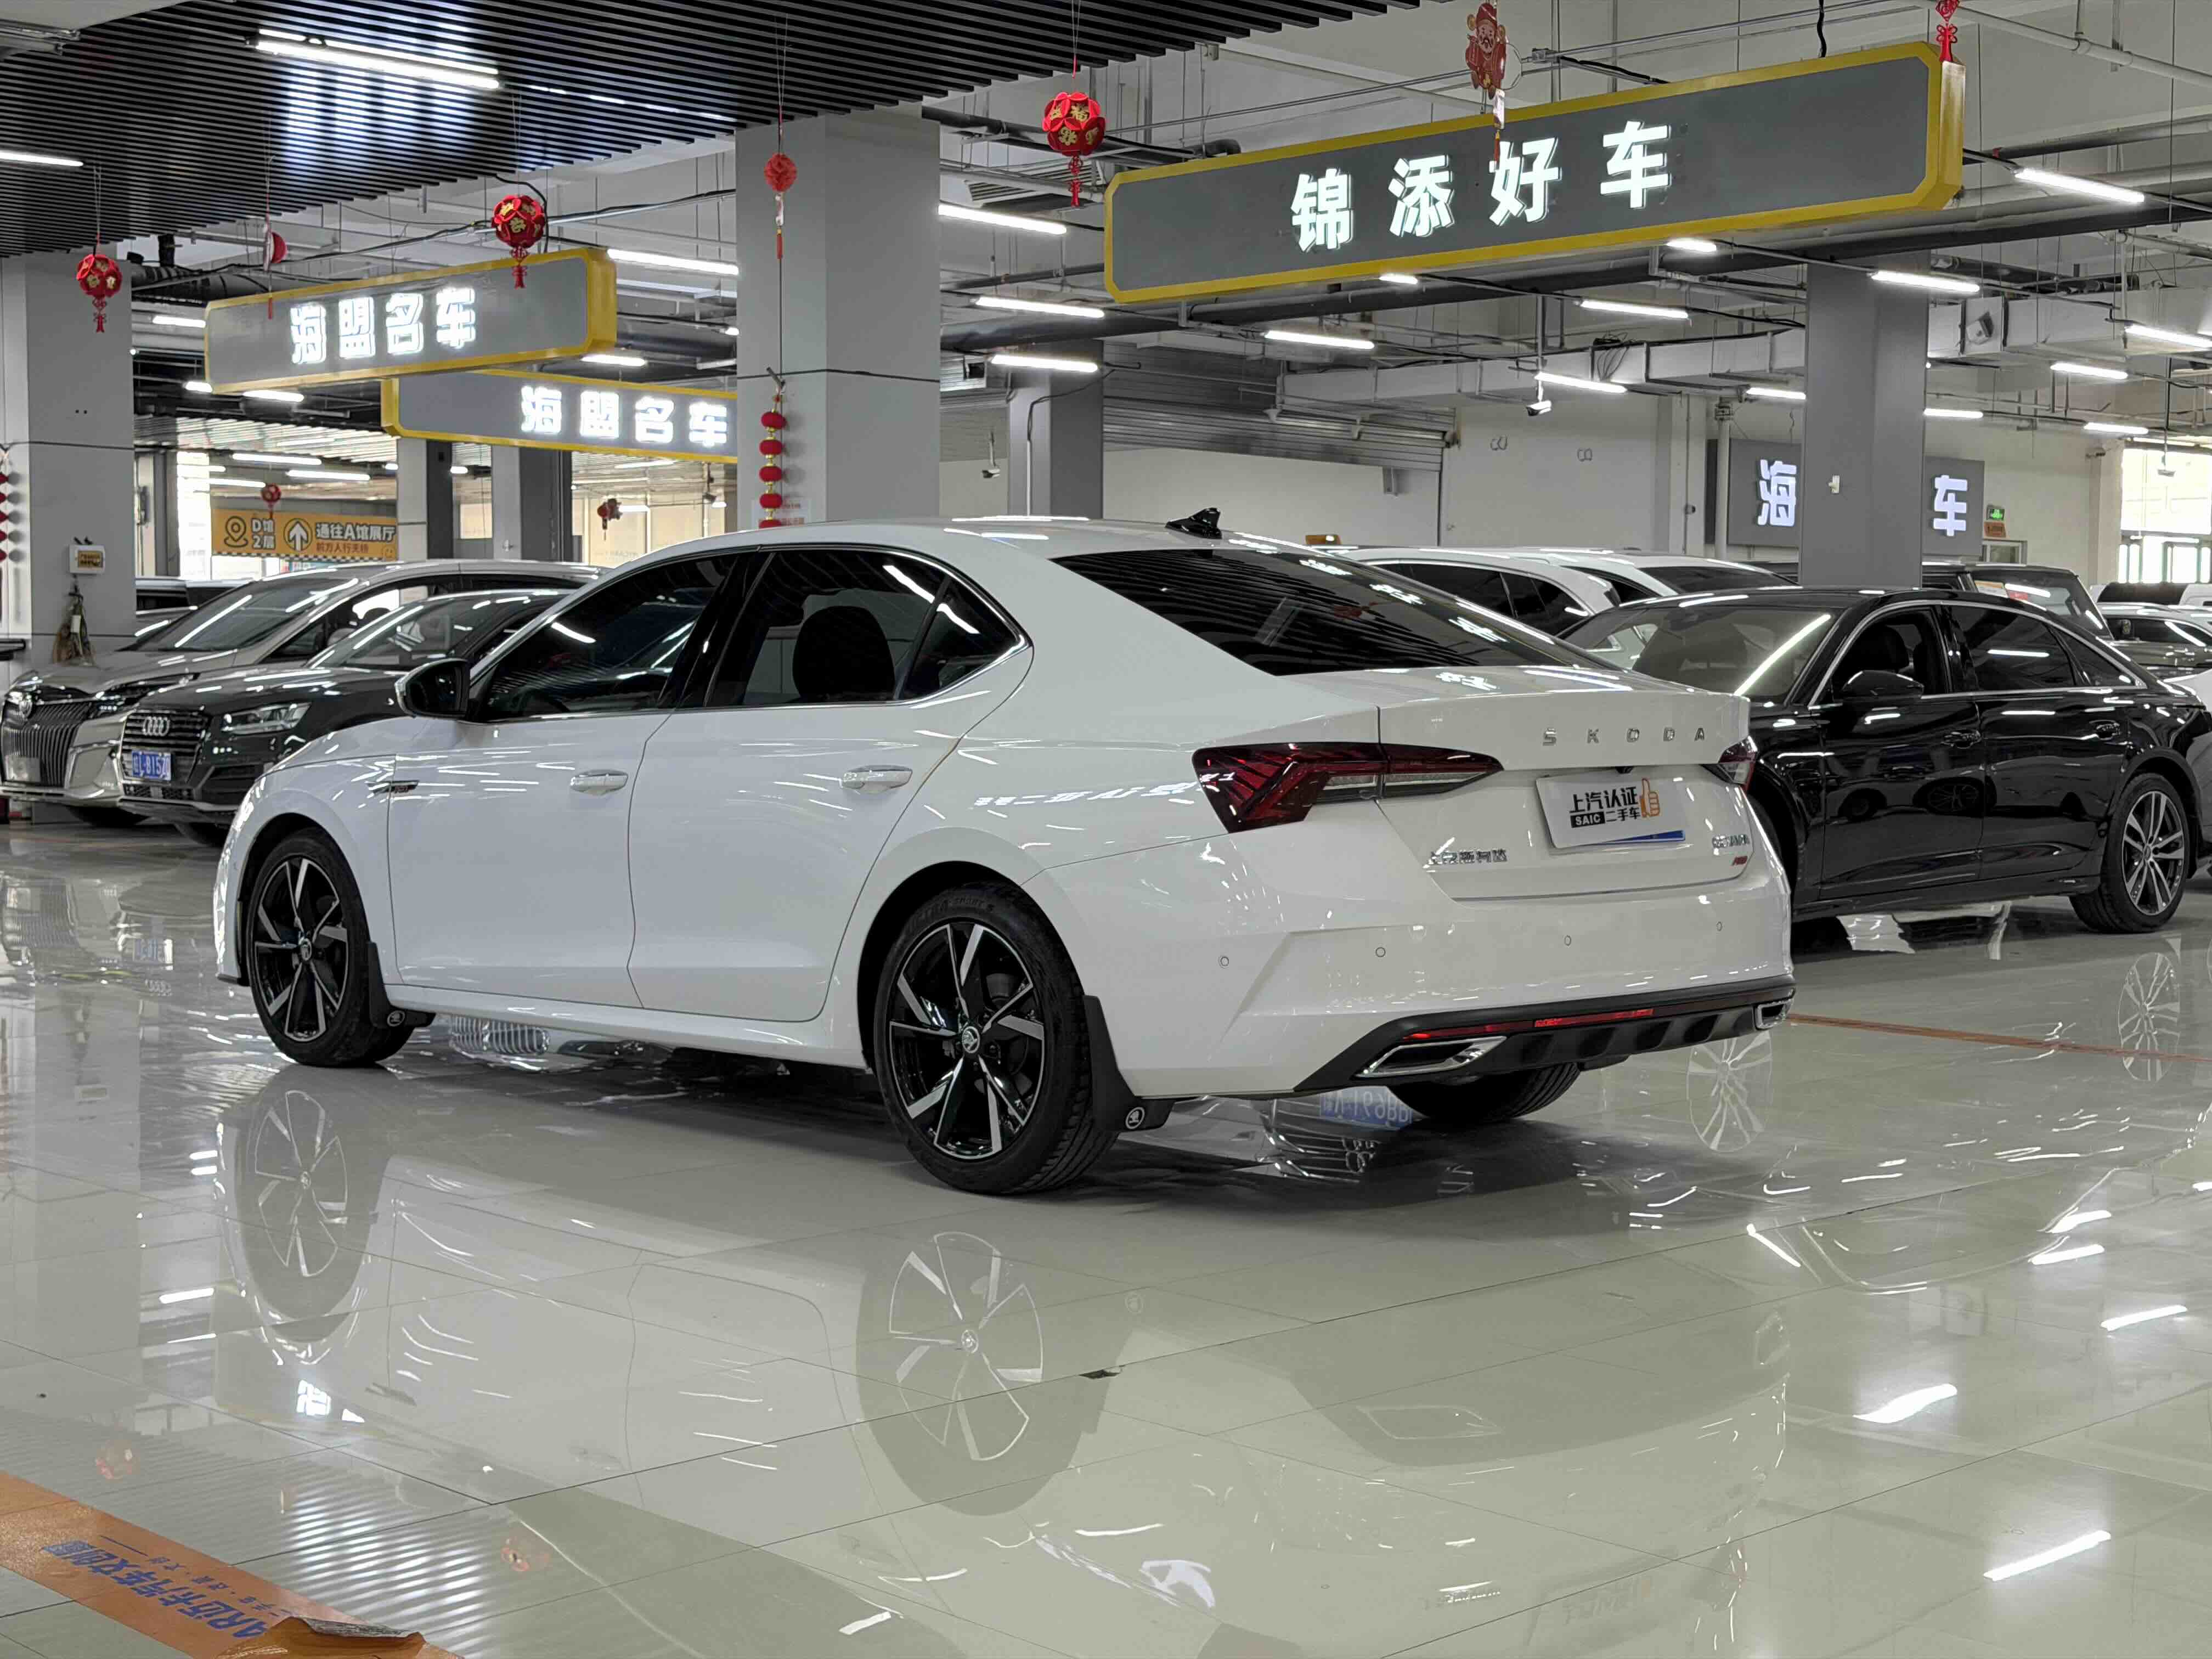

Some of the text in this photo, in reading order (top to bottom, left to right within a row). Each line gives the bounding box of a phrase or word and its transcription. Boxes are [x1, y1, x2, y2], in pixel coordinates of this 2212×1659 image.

[1291, 120, 1671, 252] 锦添好车
[290, 287, 475, 364] 海盟名车
[521, 386, 727, 447] 海盟名车
[315, 522, 396, 542] 通往A馆展厅
[1569, 786, 1639, 813] 上汽认证
[1575, 813, 1601, 826] SAIC
[1605, 807, 1640, 822] 二手车
